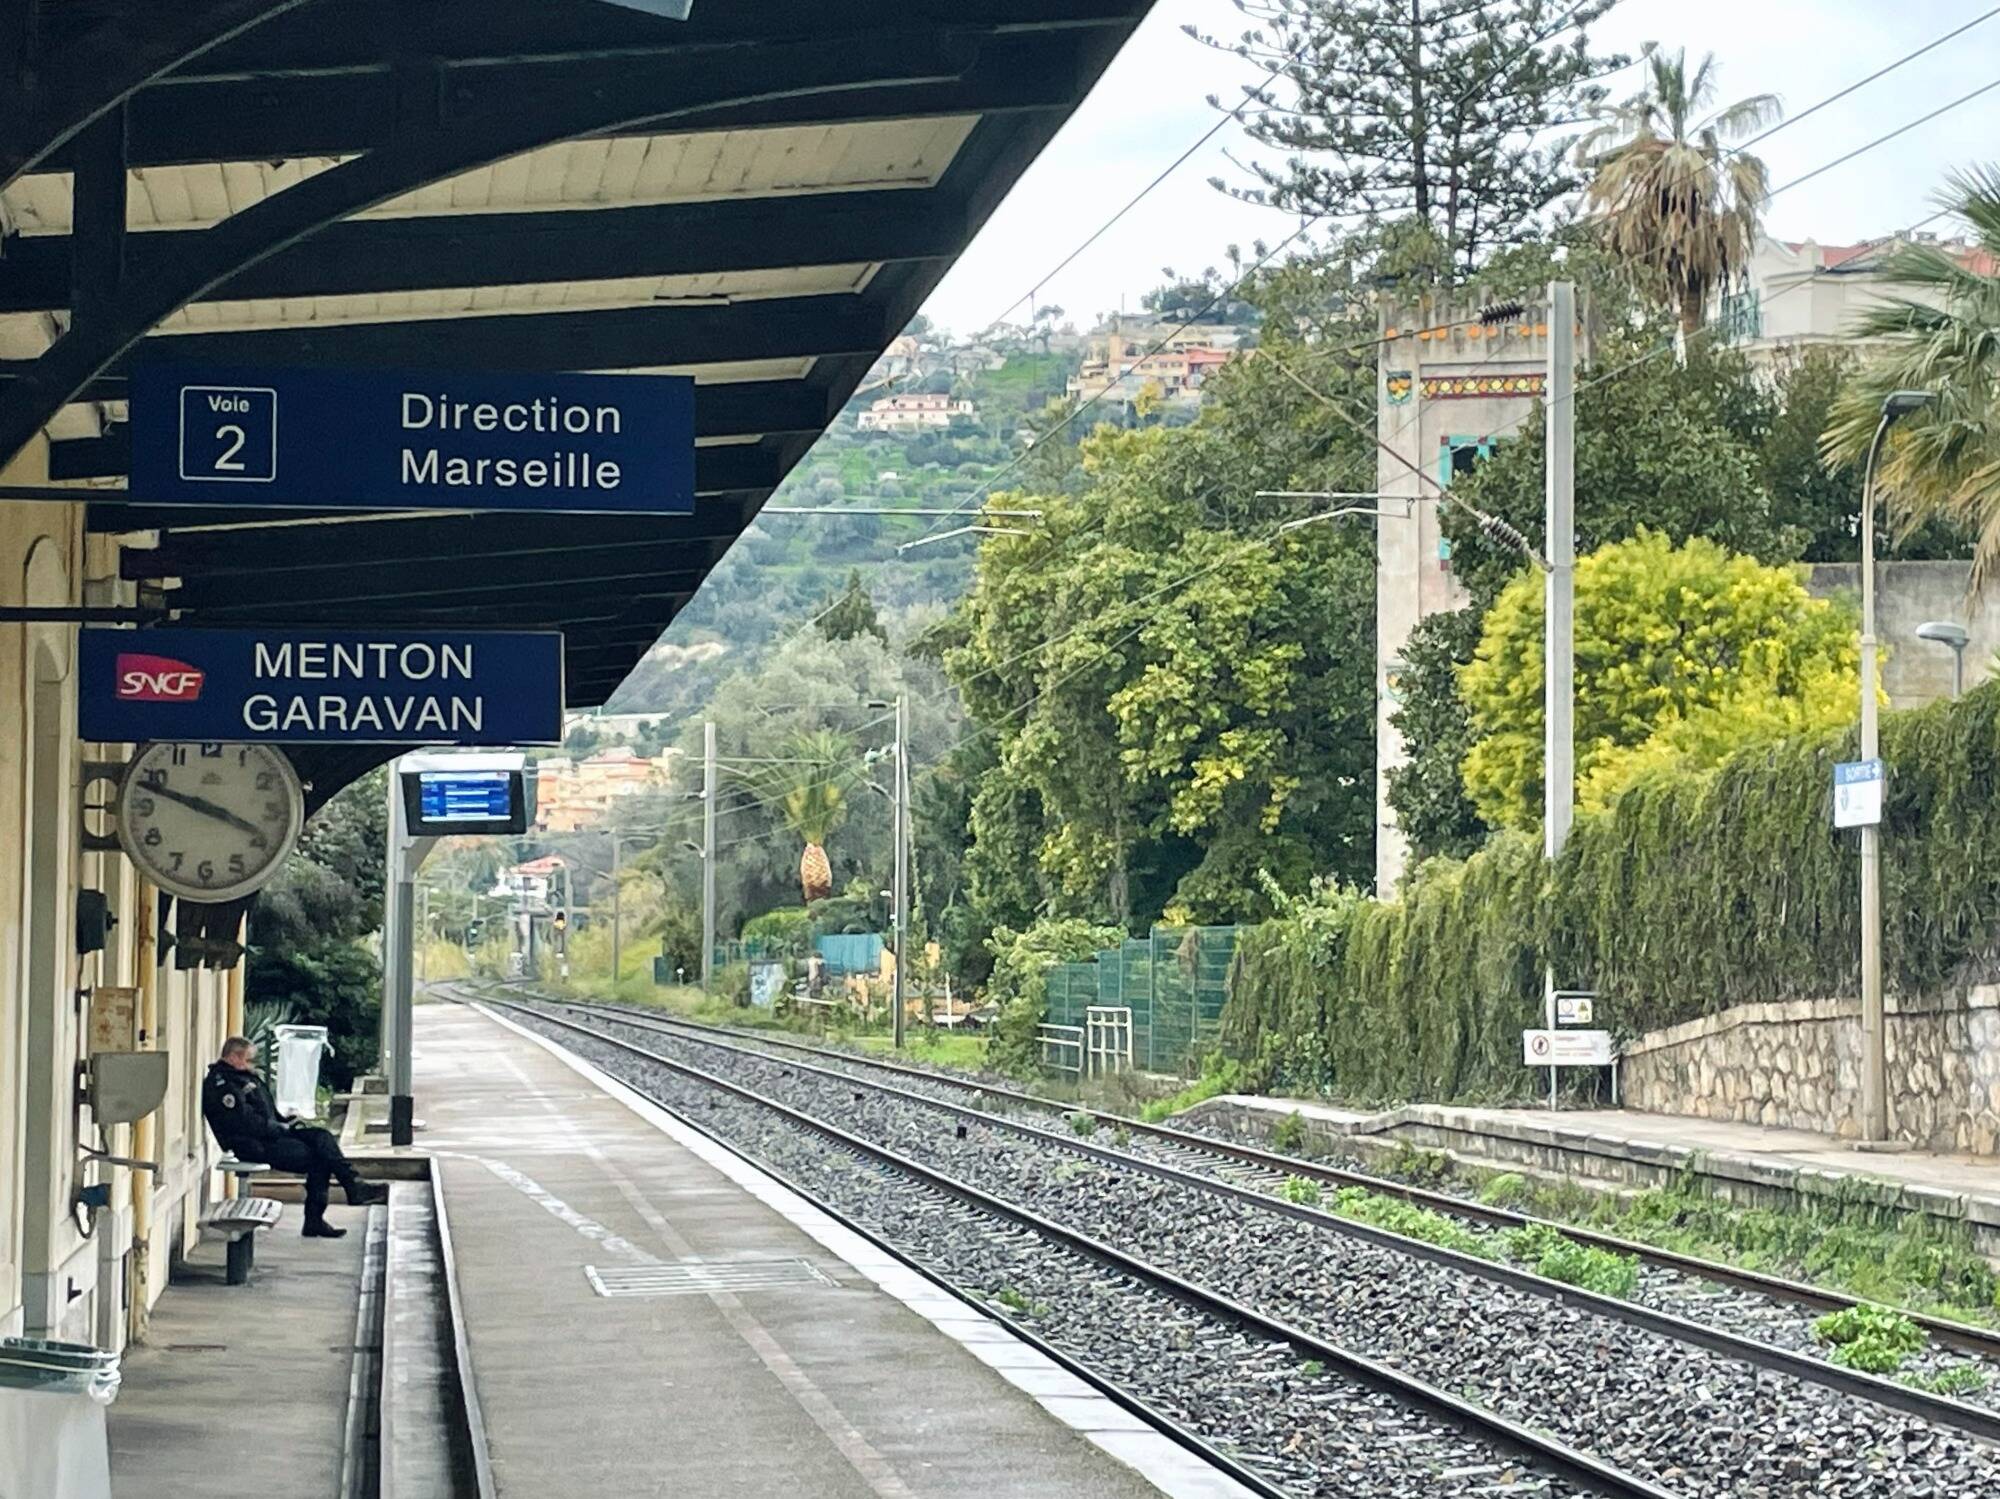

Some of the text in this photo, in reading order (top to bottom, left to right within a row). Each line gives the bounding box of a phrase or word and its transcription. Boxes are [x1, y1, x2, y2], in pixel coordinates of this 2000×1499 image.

[208, 394, 250, 413] Voie
[401, 392, 621, 434] Direction
[214, 424, 246, 471] 2
[401, 448, 621, 489] Marseille
[254, 642, 473, 680] MENTON
[120, 671, 203, 696] SNCF
[242, 694, 483, 732] GARAVAN
[144, 827, 162, 847] 8
[169, 851, 184, 872] 7
[197, 860, 214, 881] 6
[228, 853, 245, 873] 5
